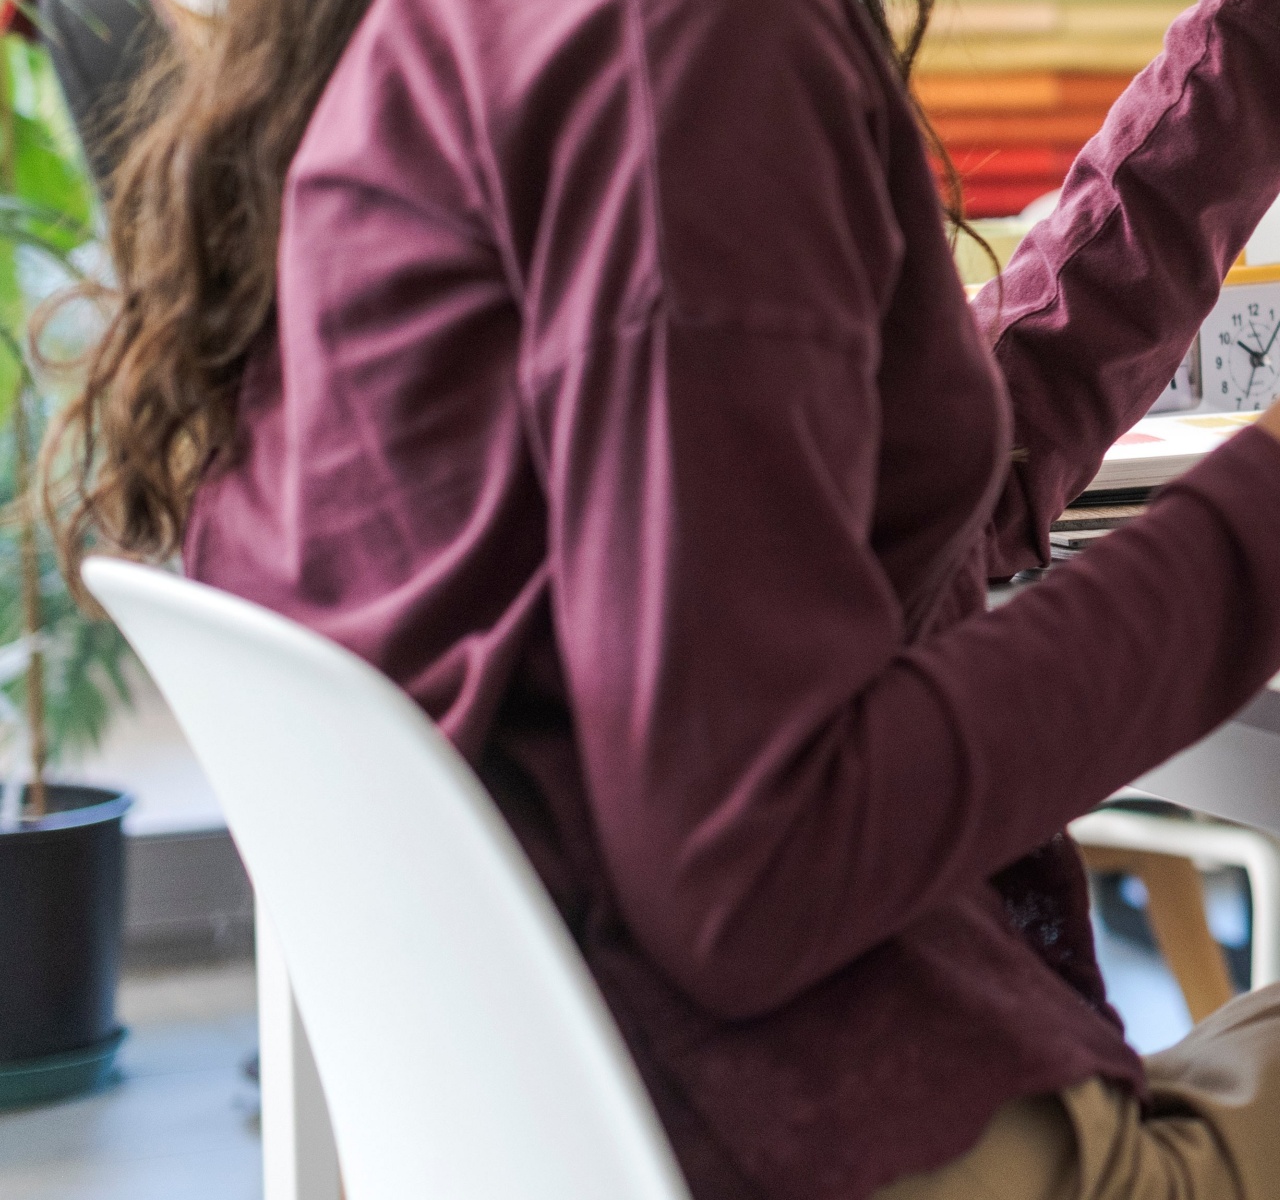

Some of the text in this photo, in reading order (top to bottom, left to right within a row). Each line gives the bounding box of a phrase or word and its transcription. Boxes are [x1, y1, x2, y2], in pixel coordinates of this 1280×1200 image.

[1248, 303, 1259, 316] 12
[1269, 308, 1274, 321] 1
[1232, 314, 1242, 326] 11
[1219, 332, 1230, 345] 10
[1216, 356, 1222, 370] 9
[1221, 381, 1228, 394] 8
[1235, 397, 1242, 410] 7
